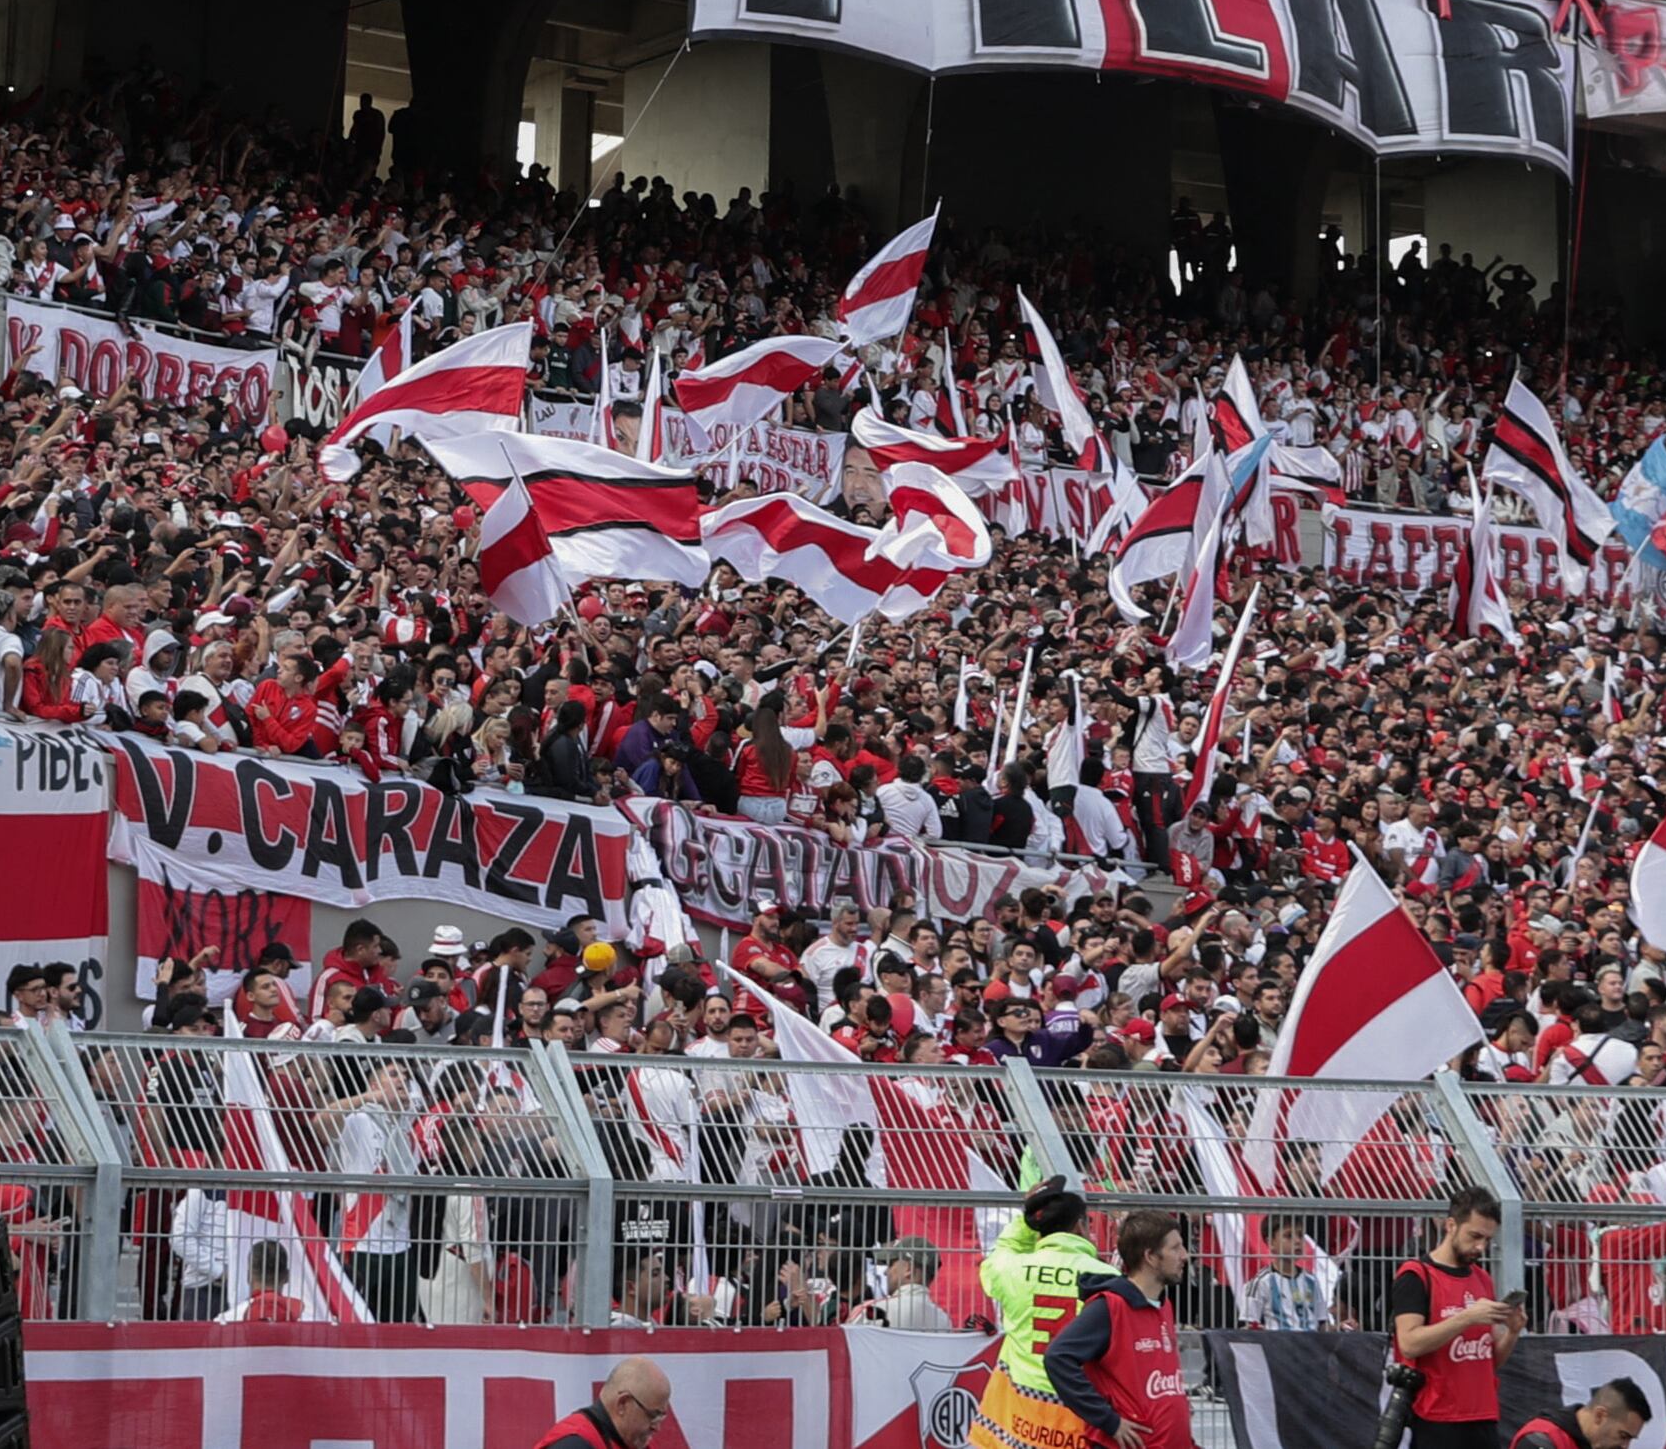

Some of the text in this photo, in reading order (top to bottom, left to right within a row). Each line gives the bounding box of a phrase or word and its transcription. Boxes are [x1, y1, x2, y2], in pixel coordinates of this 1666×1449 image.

[767, 423, 832, 476] ESTAR
[13, 724, 103, 794] PIBES
[239, 755, 606, 920] CARAZA
[1022, 1264, 1082, 1287] TEC
[1032, 1293, 1077, 1356] 3
